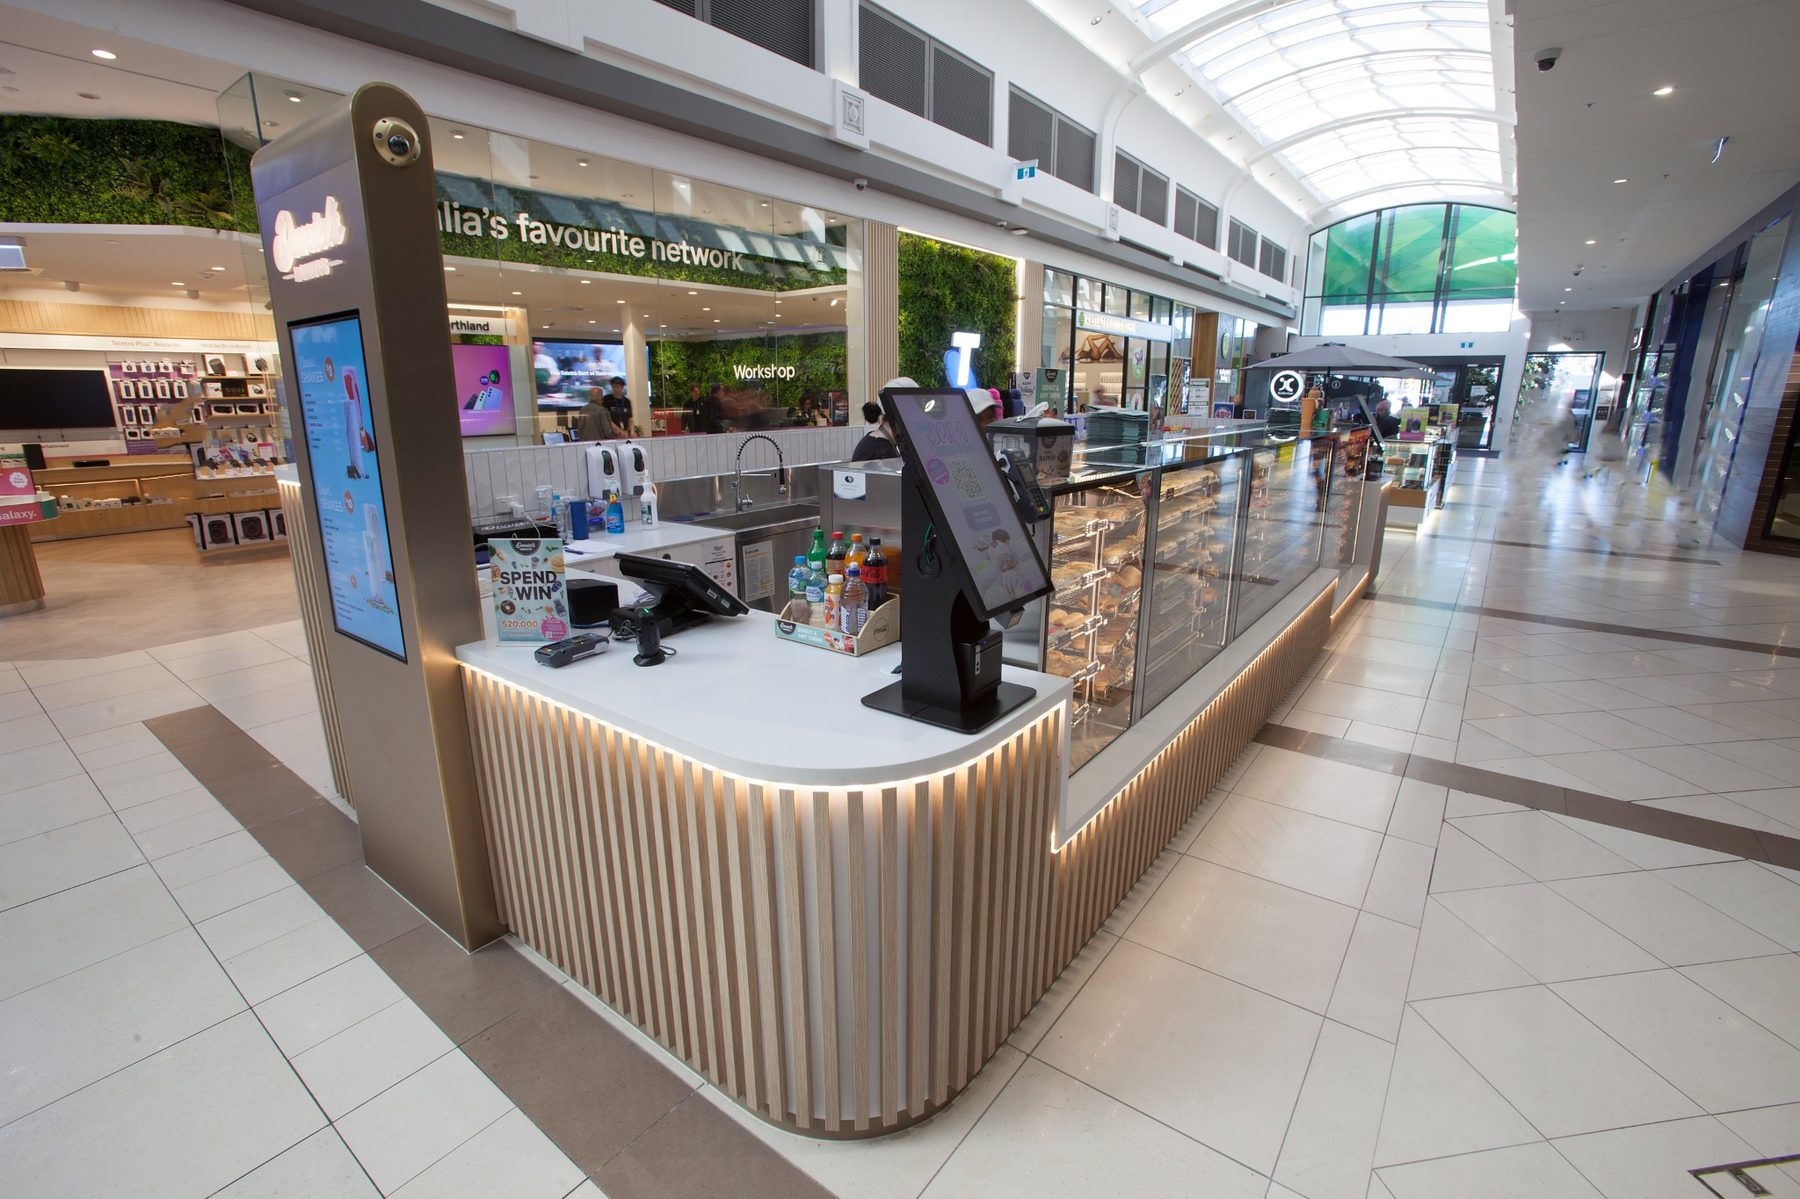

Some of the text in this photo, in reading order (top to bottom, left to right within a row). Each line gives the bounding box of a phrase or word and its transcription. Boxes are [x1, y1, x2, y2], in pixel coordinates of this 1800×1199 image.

[437, 201, 744, 272] lia's favourite network
[449, 320, 490, 332] rthland
[733, 364, 795, 381] Workshop
[500, 570, 557, 585] SPEND
[515, 586, 552, 601] WIN
[501, 620, 538, 628] $20,000
